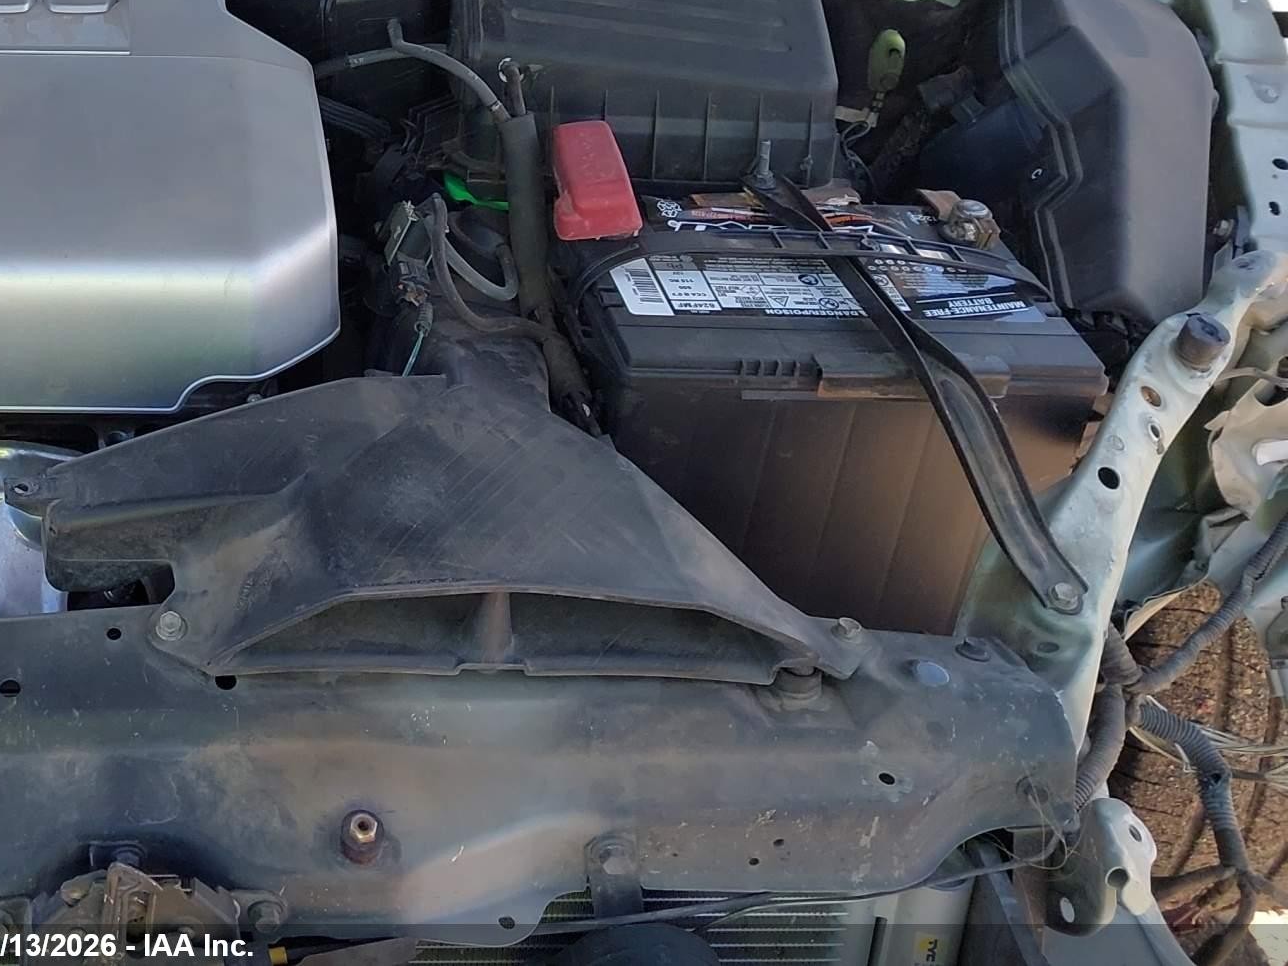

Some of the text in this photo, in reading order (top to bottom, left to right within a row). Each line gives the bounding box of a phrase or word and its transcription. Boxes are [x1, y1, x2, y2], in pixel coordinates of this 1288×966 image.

[922, 300, 1027, 318] MAINTENANCE-FREE
[947, 297, 994, 308] BATTERY
[926, 938, 938, 962] TYC
